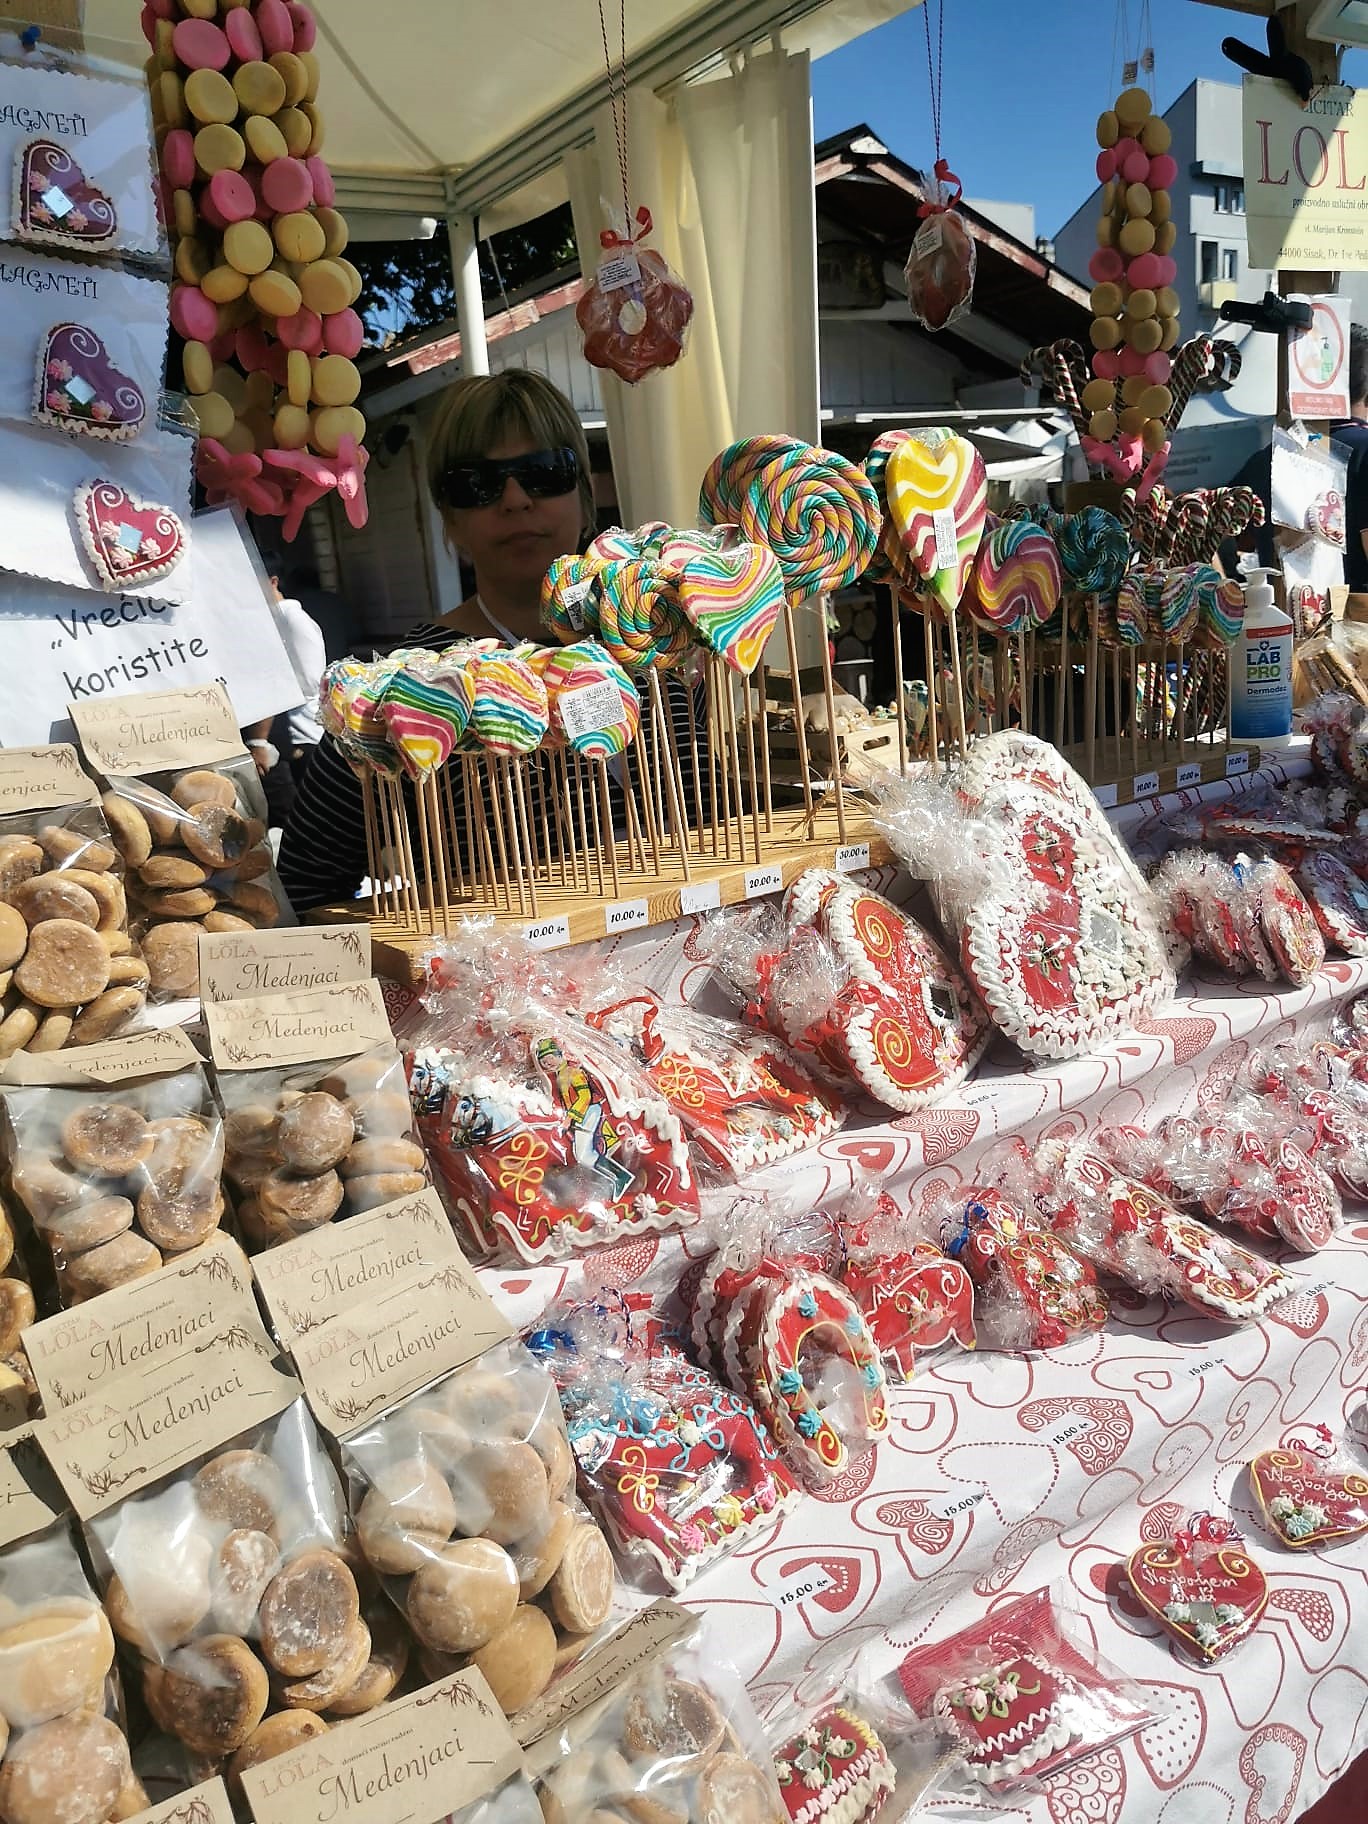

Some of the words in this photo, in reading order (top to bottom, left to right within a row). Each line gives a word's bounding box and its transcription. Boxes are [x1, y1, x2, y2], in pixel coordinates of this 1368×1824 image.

[0, 103, 88, 137] AGNETI
[63, 638, 208, 700] koristite
[1246, 650, 1281, 666] LAB
[1246, 664, 1281, 679] PRO
[118, 718, 212, 749] Medenjaci
[749, 875, 771, 889] 20.00
[611, 910, 634, 924] 10.00
[528, 924, 554, 939] 10.00
[209, 944, 258, 960] LOLA
[236, 962, 340, 990] Medenjaci
[248, 1017, 355, 1042] Medenjaci
[310, 1240, 423, 1303] Medenjaci
[87, 1302, 216, 1381] Medenjaci
[349, 1310, 463, 1389] Medenjaci
[108, 1368, 244, 1460] Medenjaci
[1052, 1426, 1078, 1444] 15.00
[943, 1498, 974, 1517] 15.00
[780, 1583, 813, 1605] 15.00
[258, 1753, 335, 1798] LOLA
[318, 1727, 465, 1822] Medenjaci
